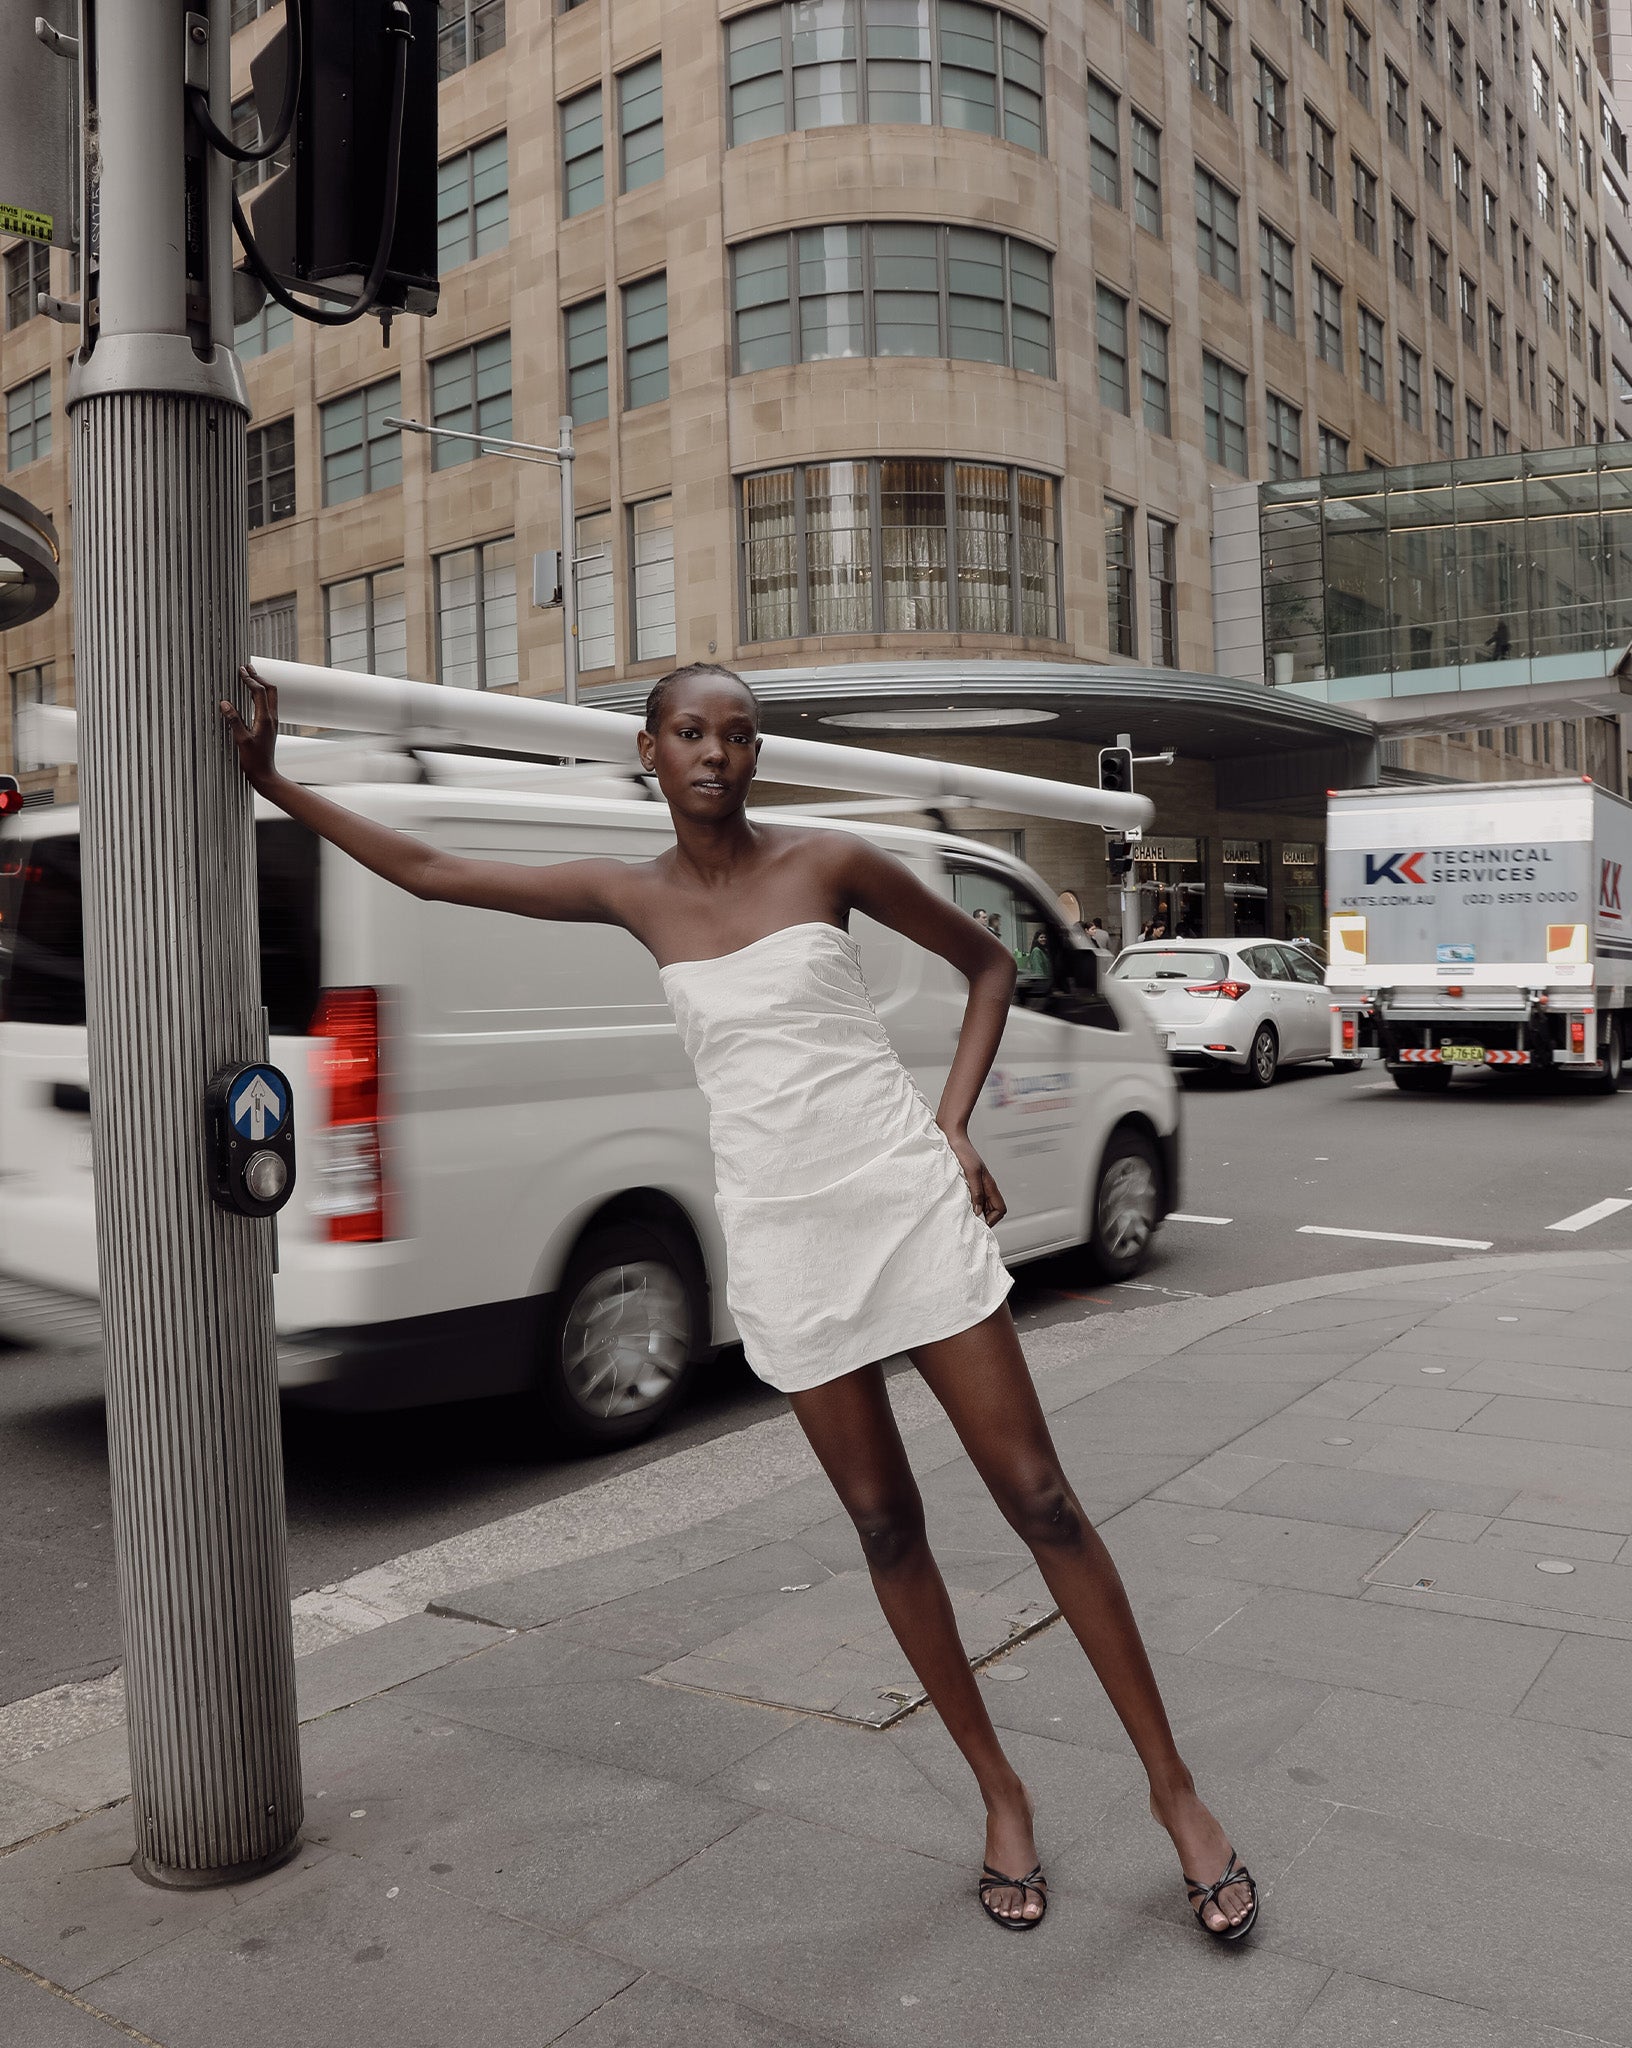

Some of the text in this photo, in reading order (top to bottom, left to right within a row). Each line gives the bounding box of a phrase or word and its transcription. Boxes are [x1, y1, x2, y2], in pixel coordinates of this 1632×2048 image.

[1134, 847, 1168, 860] CHANEL
[1224, 850, 1253, 862] CHANEL
[1284, 851, 1308, 862] CHANEL
[1365, 848, 1554, 884] KK TECHNICAL
[1431, 867, 1537, 883] SERVICES
[1599, 857, 1622, 910] KK
[1340, 895, 1435, 906] KKTS.COM.AU
[1462, 894, 1495, 906] (02)
[1537, 891, 1579, 903] 0000
